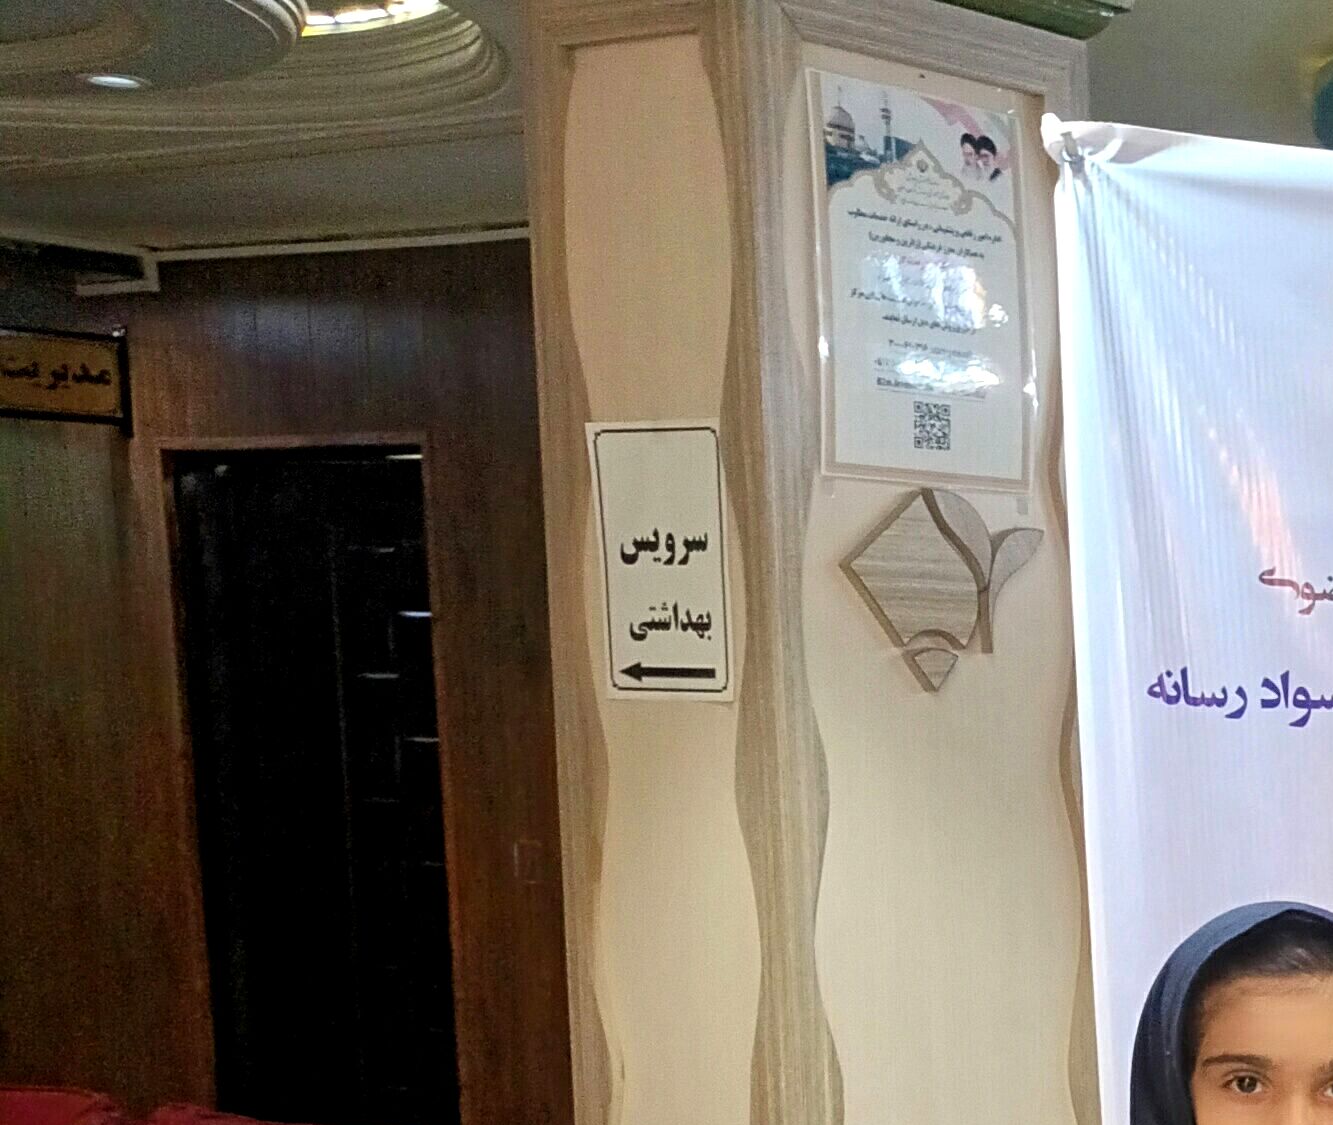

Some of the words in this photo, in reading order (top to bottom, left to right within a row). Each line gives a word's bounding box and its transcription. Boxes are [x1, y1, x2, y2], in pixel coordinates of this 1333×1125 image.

[620, 528, 708, 565] سرویس
[629, 601, 712, 641] بهداشتی
[1147, 666, 1248, 719] رسانه
